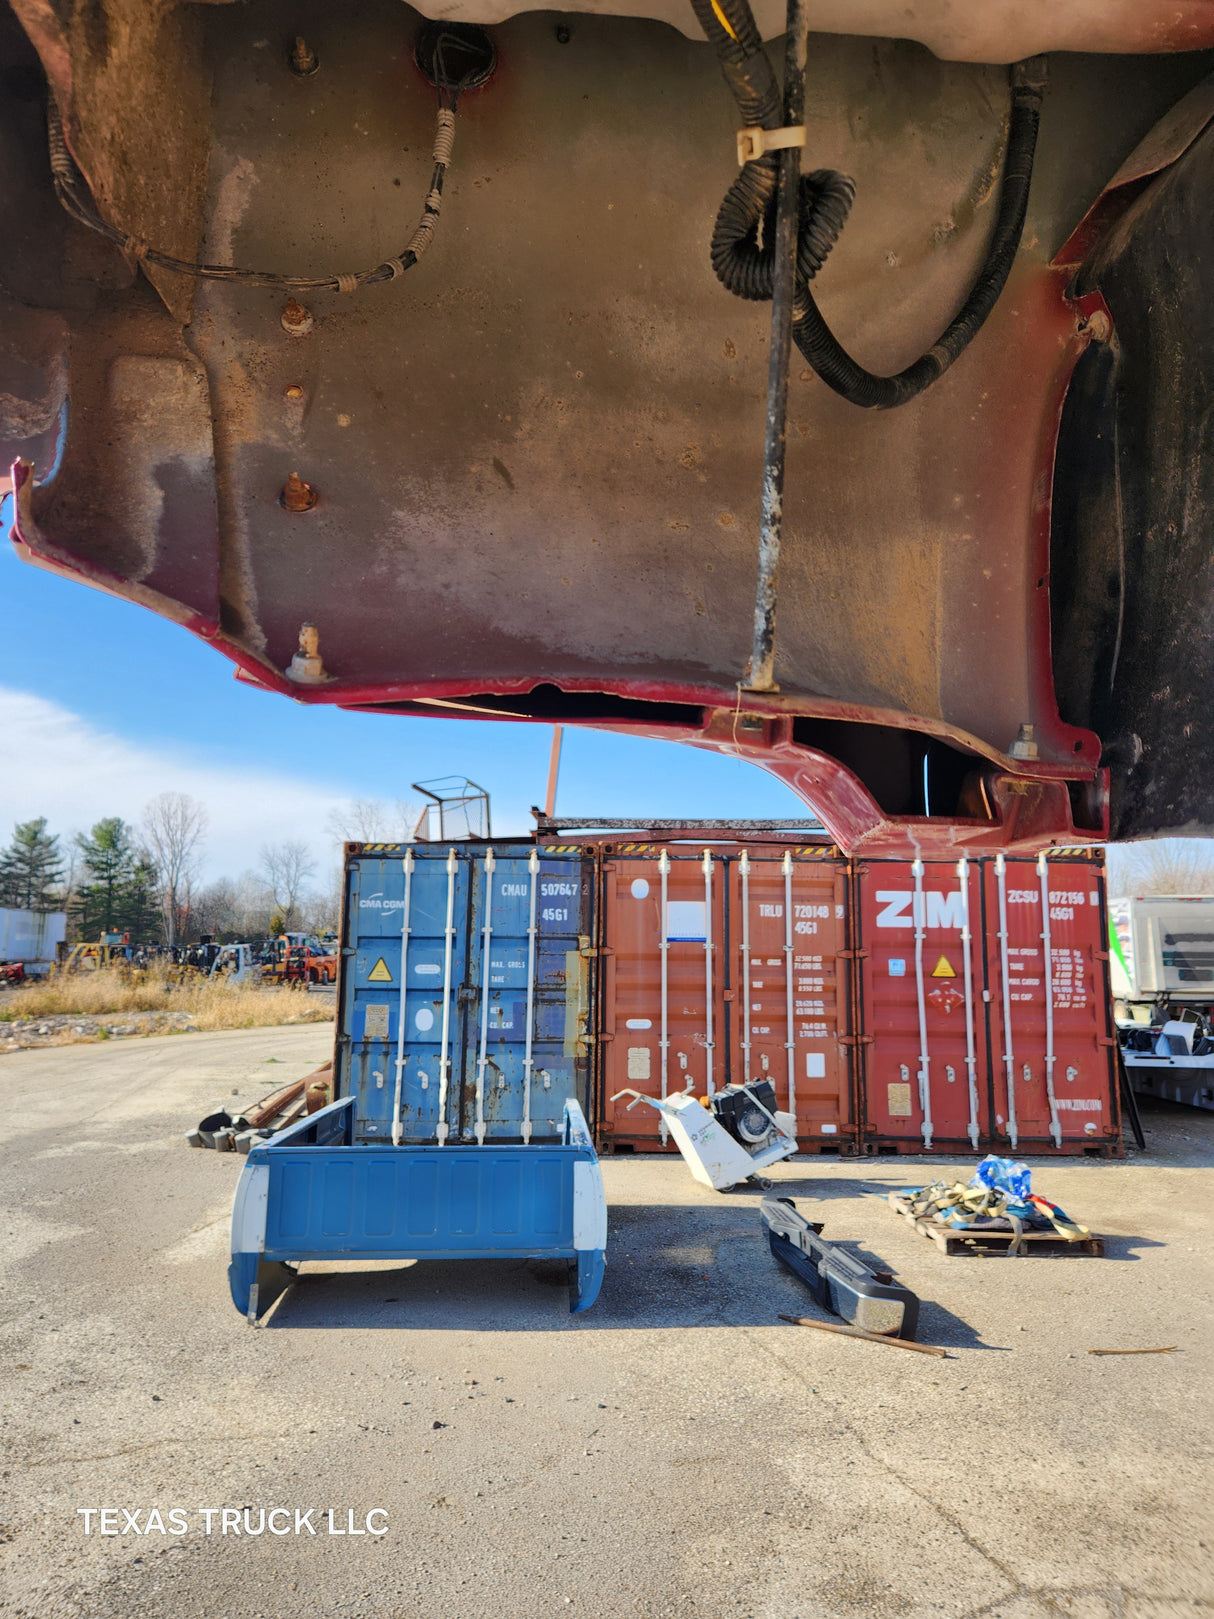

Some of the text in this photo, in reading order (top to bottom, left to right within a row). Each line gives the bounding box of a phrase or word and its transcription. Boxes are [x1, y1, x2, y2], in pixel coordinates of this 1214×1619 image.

[501, 884, 527, 896] CMAU
[541, 884, 578, 896] 507647
[1007, 890, 1039, 903] ZCSU
[359, 900, 405, 908] CMA CGM
[875, 890, 965, 928] ZIM
[542, 908, 568, 921] 45G1
[759, 904, 783, 917] TRLU
[794, 905, 829, 918] 720148
[1050, 907, 1074, 920] 45G1
